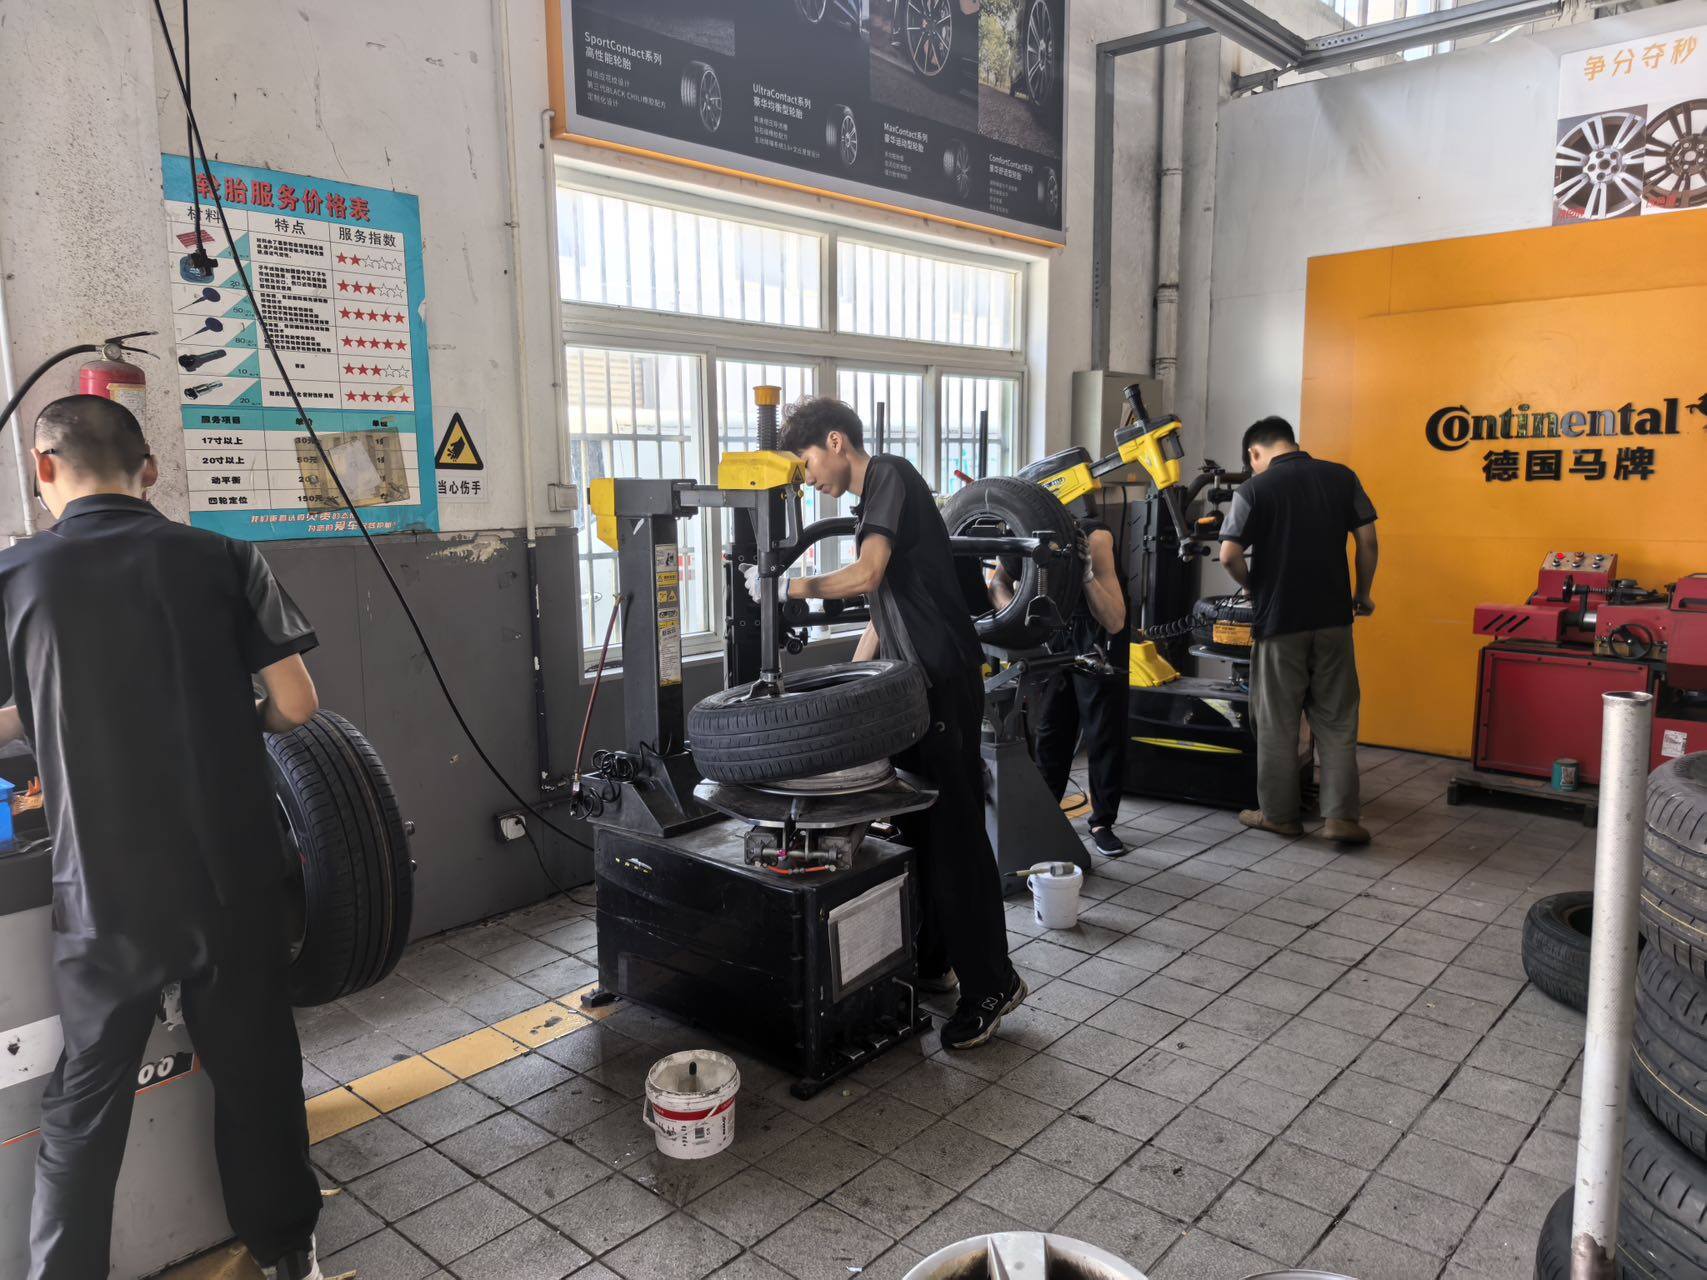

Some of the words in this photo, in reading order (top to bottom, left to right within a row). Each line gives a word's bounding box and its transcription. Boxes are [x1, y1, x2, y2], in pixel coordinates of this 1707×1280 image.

[584, 31, 662, 66] SportContact系列
[585, 46, 632, 71] 高性能轮胎
[1583, 35, 1698, 81] 争分夺秒
[752, 83, 811, 110] UltraContact系列
[195, 171, 372, 223] 轮胎服务价格表
[274, 217, 307, 236] 特点
[339, 226, 398, 248] 服务指数
[201, 415, 241, 426] 服务项目
[1425, 397, 1680, 453] Continental
[201, 436, 244, 446] 17寸以上
[202, 456, 245, 466] 20寸以上
[1482, 446, 1656, 482] 德国马牌
[211, 475, 241, 486] 动平衡
[437, 480, 482, 496] 当心伤手
[208, 495, 248, 506] 四轮定位
